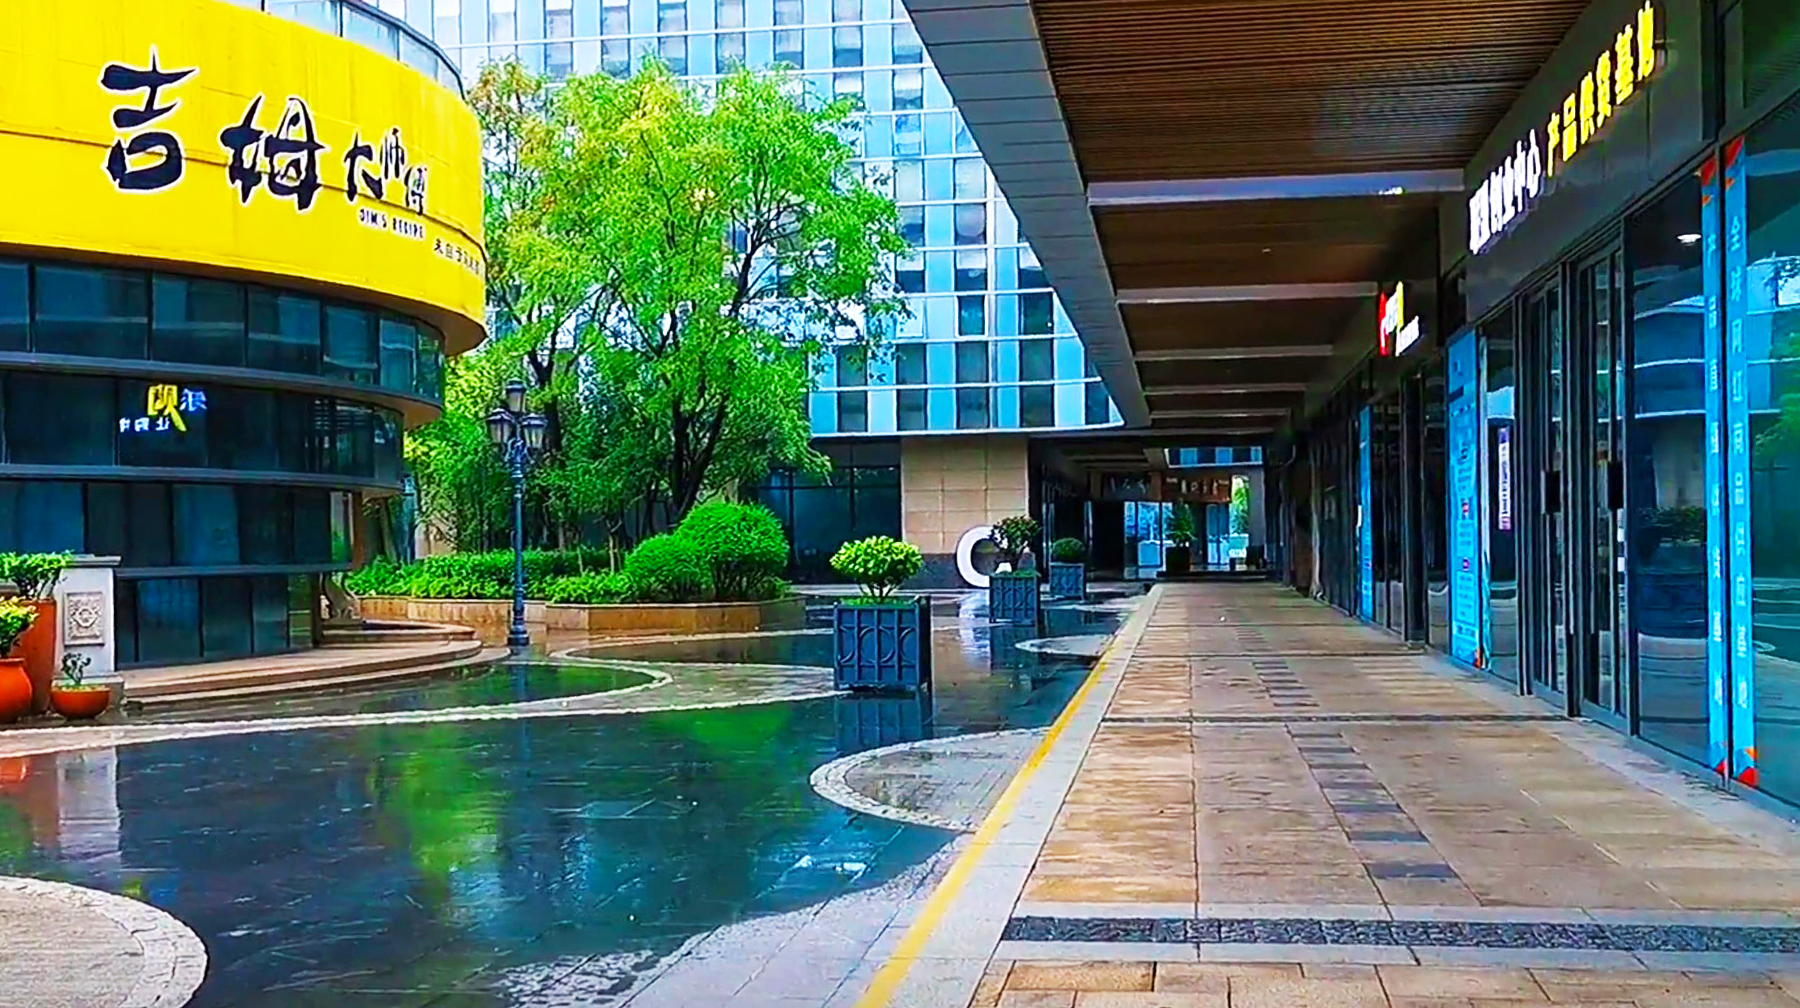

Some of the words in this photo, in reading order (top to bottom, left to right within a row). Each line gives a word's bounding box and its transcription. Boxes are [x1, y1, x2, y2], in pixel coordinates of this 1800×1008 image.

[101, 45, 428, 215] 吉姆大师傅
